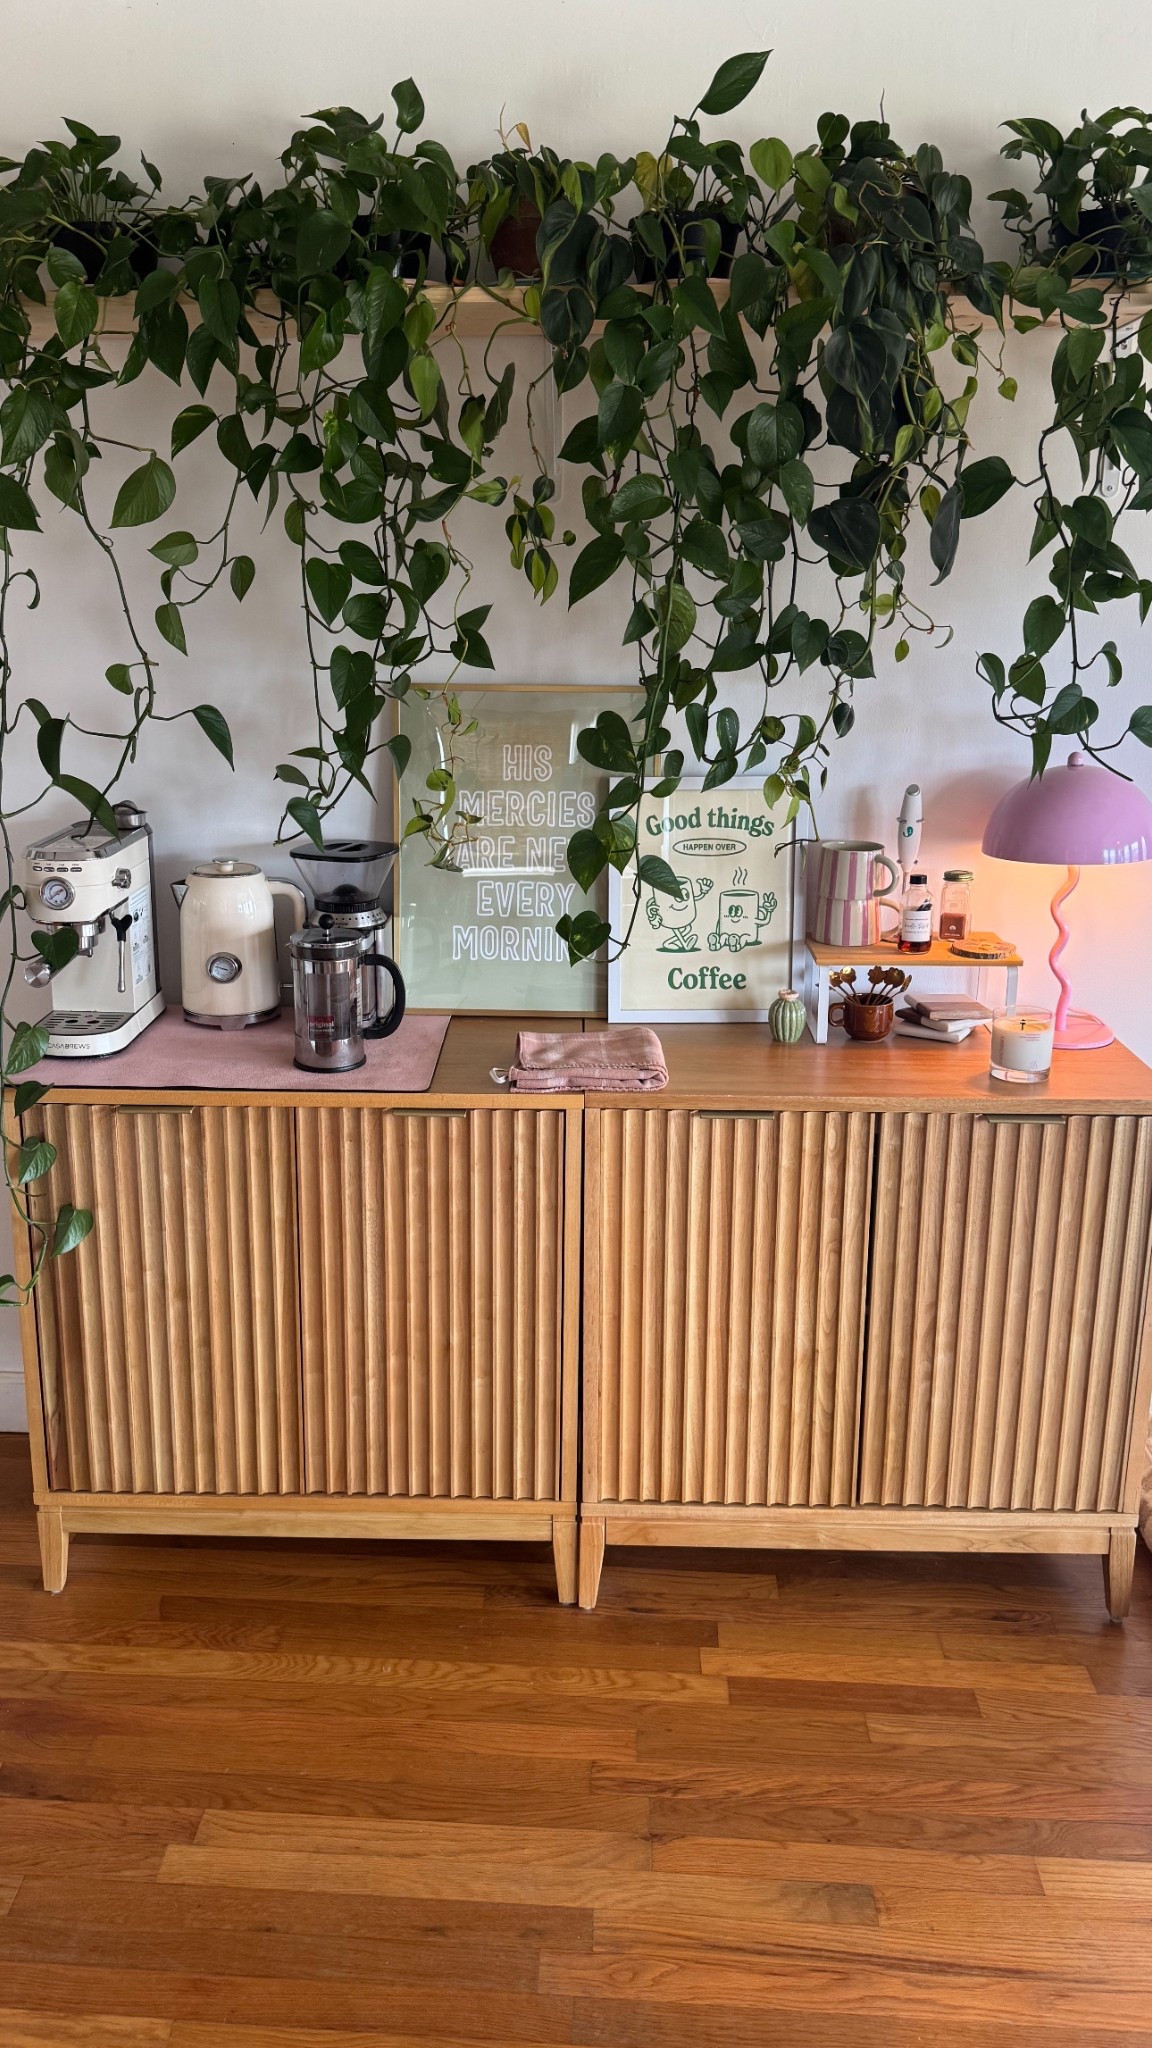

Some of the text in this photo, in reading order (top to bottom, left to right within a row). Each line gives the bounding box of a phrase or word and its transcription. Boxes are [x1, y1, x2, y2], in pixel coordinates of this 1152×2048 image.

[503, 744, 553, 782] HIS
[458, 790, 596, 828] MERCIES
[645, 806, 775, 838] Good things
[455, 836, 571, 873] ARE NE
[683, 843, 737, 851] HAPPEN OVER
[476, 880, 576, 917] EVERY
[667, 966, 747, 990] Coffee
[48, 1042, 91, 1050] CASABREWS
